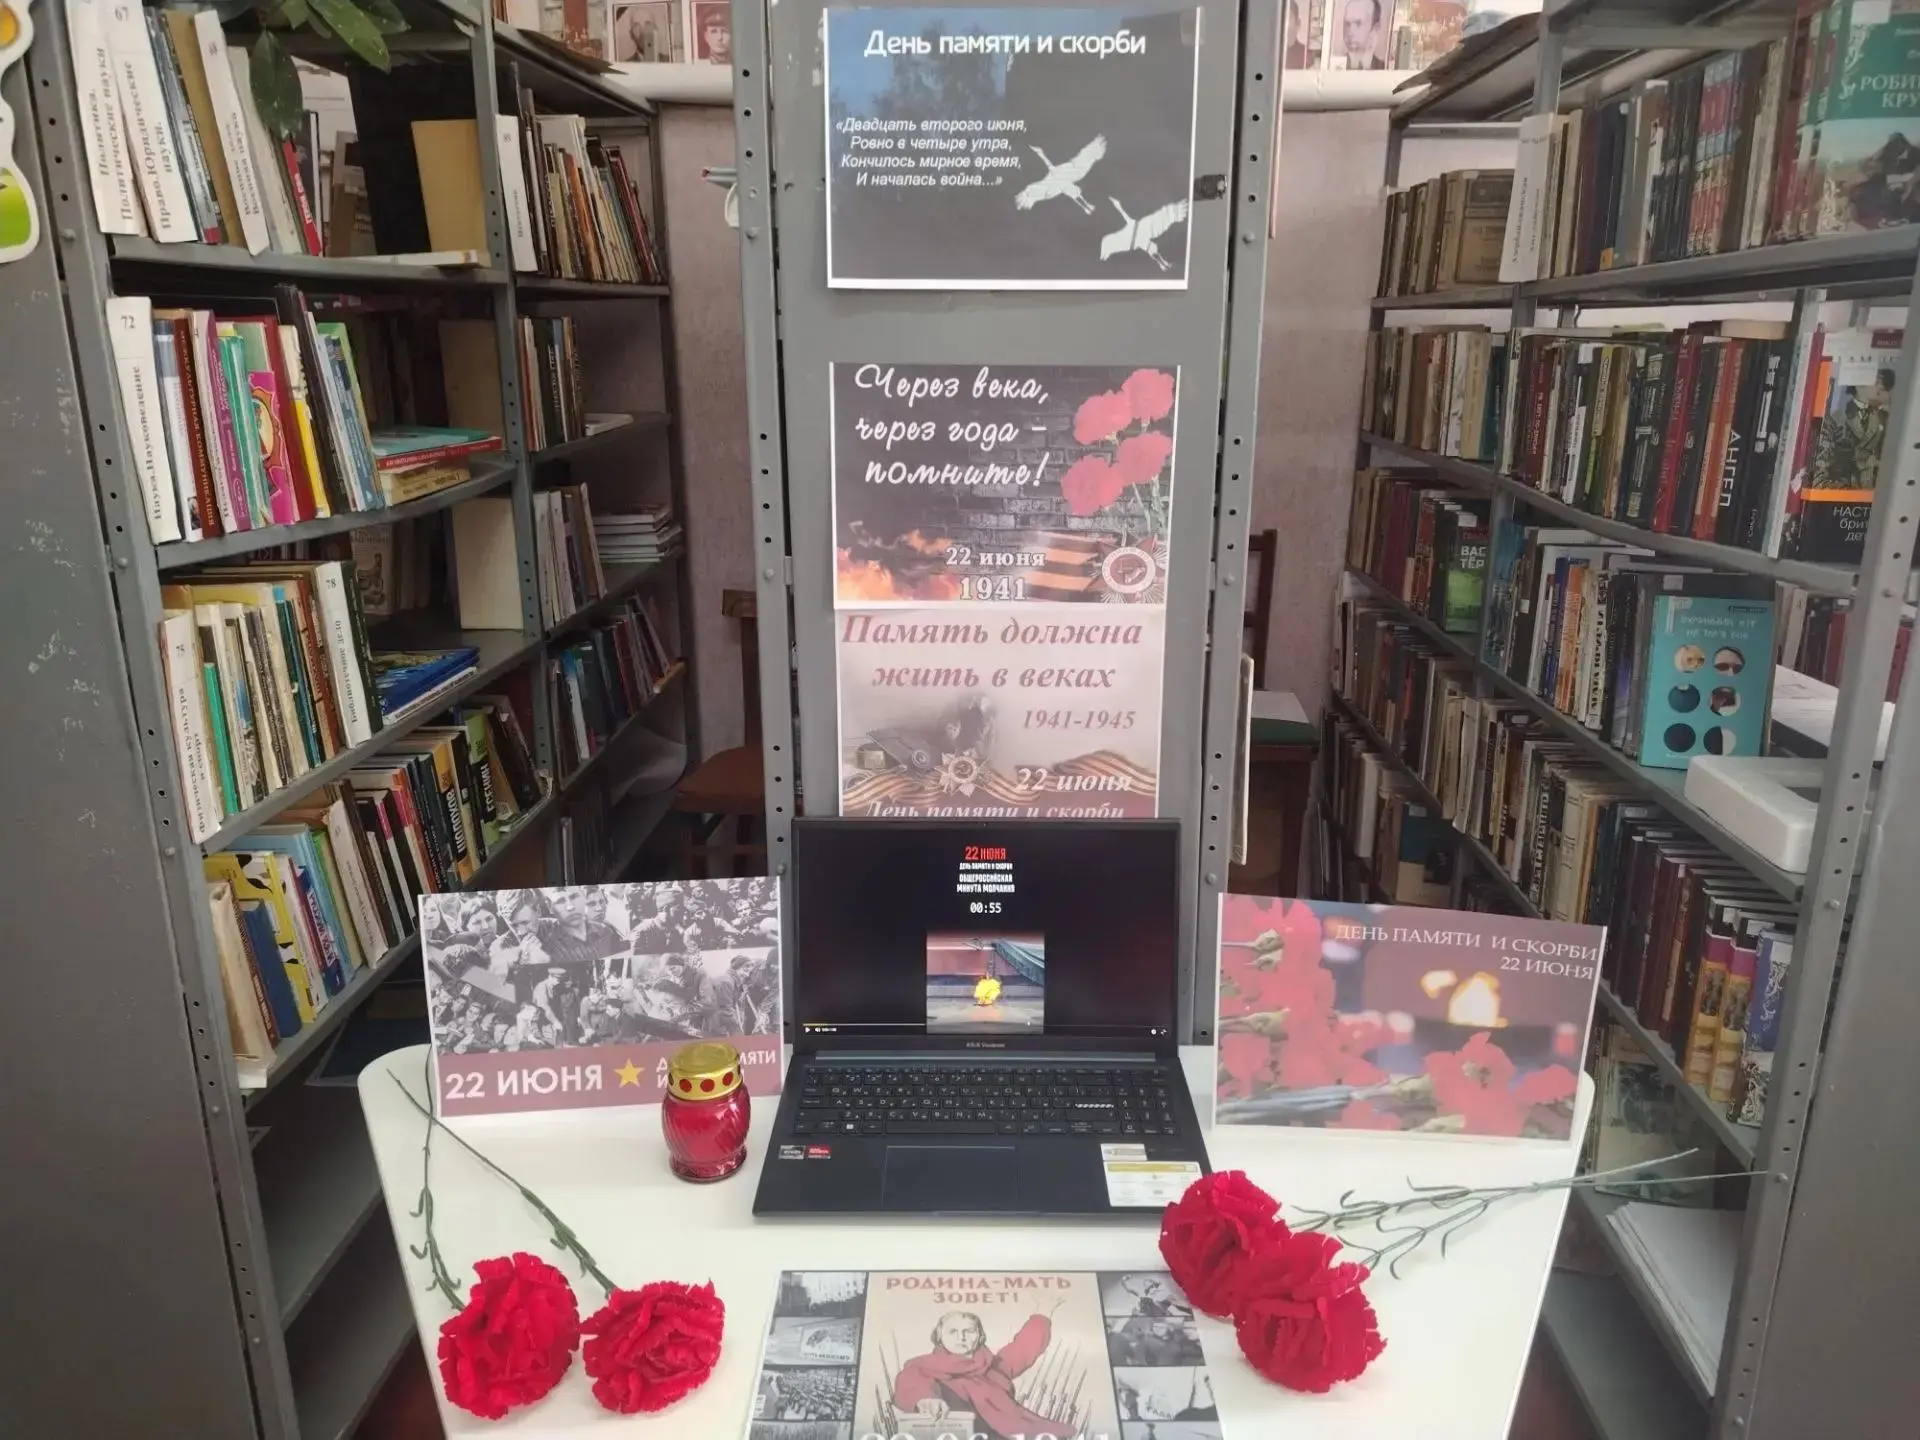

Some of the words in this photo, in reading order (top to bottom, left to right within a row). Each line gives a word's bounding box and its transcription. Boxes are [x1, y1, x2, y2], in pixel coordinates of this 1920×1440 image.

[864, 30, 931, 57] День
[940, 35, 1030, 54] памяти
[1037, 36, 1052, 53] и
[1060, 30, 1146, 60] скорби
[96, 48, 112, 101] науки
[835, 118, 916, 134] «Двадцать
[920, 118, 983, 132] второго
[986, 119, 1028, 133] июня,
[850, 136, 894, 151] Ровно
[897, 139, 906, 151] в
[910, 139, 967, 153] четыре
[970, 138, 1012, 153] утра,
[105, 104, 133, 221] Политические
[840, 153, 915, 168] Кончилось
[919, 156, 970, 170] мирное
[974, 156, 1022, 170] время,
[856, 172, 868, 186] И
[871, 173, 936, 187] началась
[120, 315, 136, 330] 72
[854, 364, 960, 408] Через
[972, 366, 1050, 404] века,
[855, 417, 936, 450] через
[948, 421, 1019, 451] года
[864, 451, 1050, 487] помните!
[1718, 429, 1742, 508] АНГЕЛ
[945, 548, 973, 567] 22
[977, 552, 1046, 567] июня
[960, 576, 1028, 600] 1941
[841, 615, 989, 644] Память
[1000, 617, 1142, 645] должна
[872, 666, 980, 688] жить
[991, 668, 1008, 688] в
[1018, 666, 1115, 688] веках
[1021, 709, 1136, 730] 1941-1945
[1014, 768, 1046, 792] 22
[1056, 772, 1132, 792] июня
[965, 846, 979, 860] 22
[980, 848, 1006, 860] ИЮНЯ
[957, 884, 981, 893] МИНУТА
[982, 884, 1015, 893] МОЛЧАНИЯ
[970, 902, 1002, 913] 00:55
[1335, 925, 1389, 942] ДЕНЬ
[1392, 927, 1481, 948] ПАМЯТИ
[1491, 936, 1507, 951] И
[1511, 938, 1598, 961] СКОРБИ
[1500, 956, 1520, 972] 22
[1524, 959, 1595, 980] ИЮНЯ
[445, 1072, 486, 1100] 22
[497, 1064, 602, 1096] ИЮНЯ
[886, 1276, 1072, 1291] РОДИНА-МАТЬ
[933, 1291, 1020, 1304] ЗОВЕТ!
